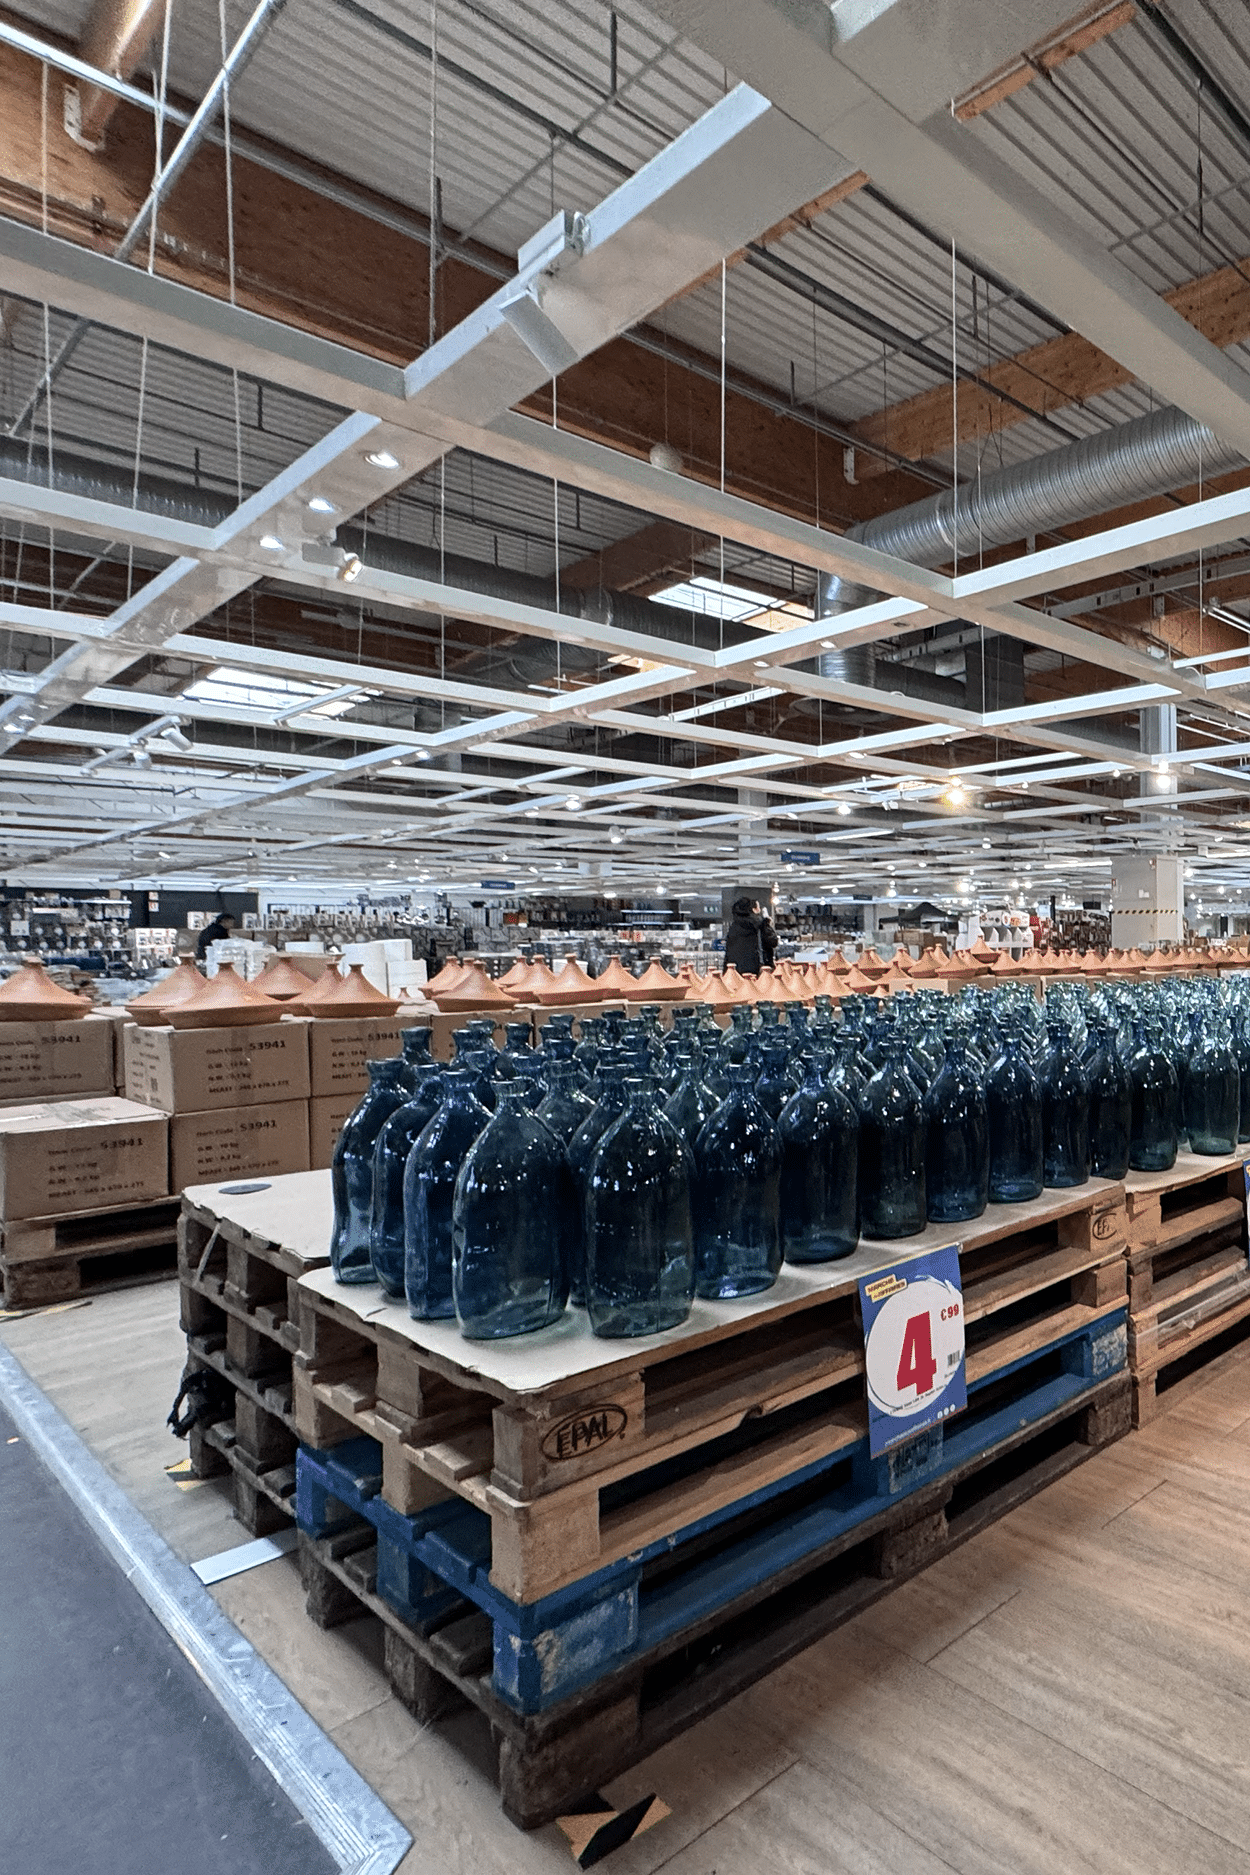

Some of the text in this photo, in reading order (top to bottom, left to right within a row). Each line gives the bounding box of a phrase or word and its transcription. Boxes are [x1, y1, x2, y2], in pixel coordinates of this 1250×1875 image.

[367, 1033, 400, 1042] 53941
[249, 1040, 286, 1050] 53941
[240, 1120, 277, 1132] 53941
[896, 1310, 938, 1397] 4
